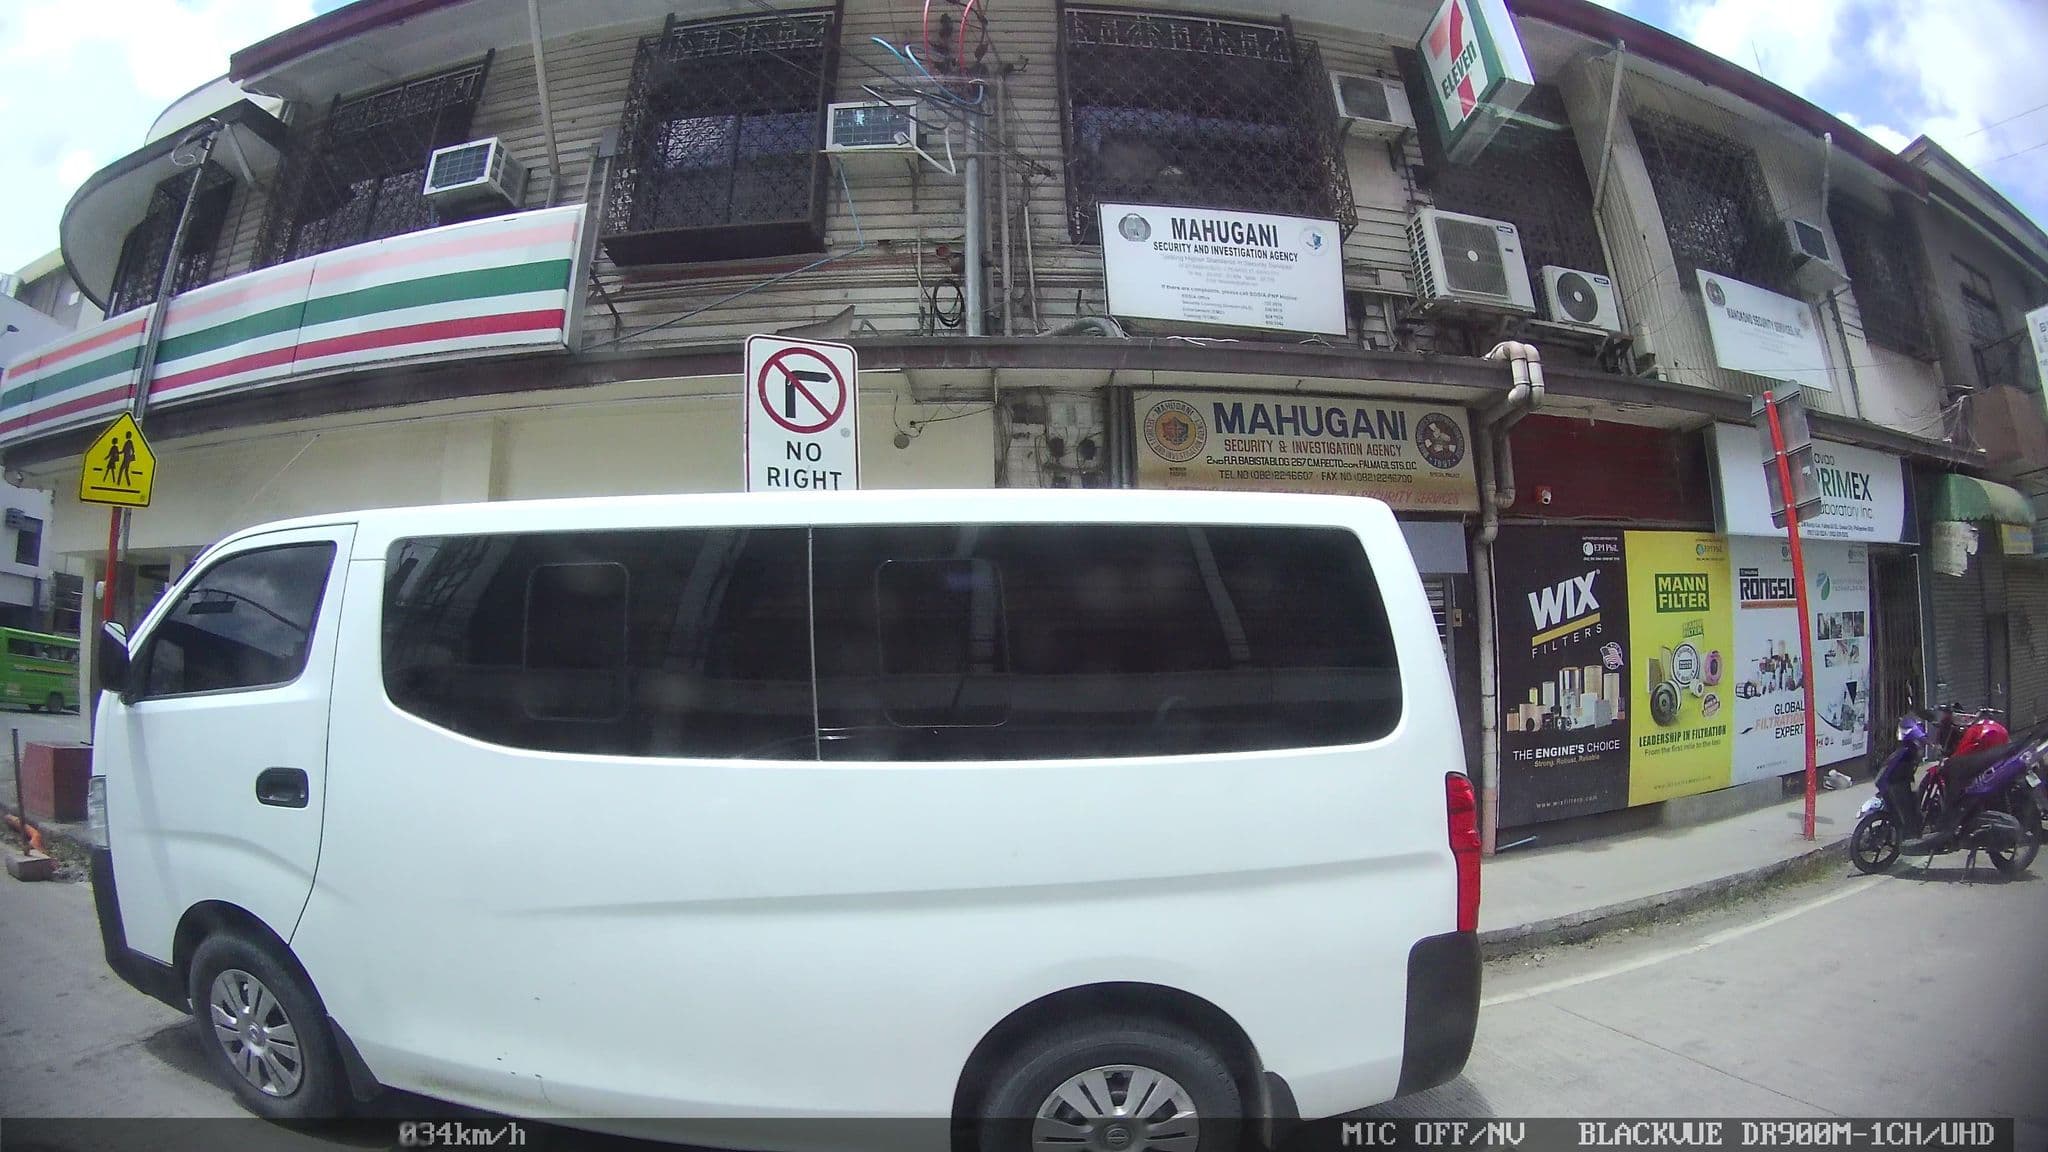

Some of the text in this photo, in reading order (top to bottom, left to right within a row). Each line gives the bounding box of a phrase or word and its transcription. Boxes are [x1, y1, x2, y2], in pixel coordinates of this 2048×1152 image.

[1170, 217, 1279, 248] MAHUGANI
[1153, 241, 1298, 262] SECURITY AND INVESTIGATION AGENCY
[1212, 402, 1408, 441] MAHUGANI
[786, 440, 822, 462] NO
[1224, 439, 1402, 457] SECURITY & INVESTIGATION AGENCY
[1813, 453, 1835, 466] avao
[767, 466, 842, 490] RIGHT
[1321, 471, 1337, 480] FAX
[1658, 576, 1707, 592] MANN
[1528, 570, 1600, 630] WIX
[1659, 592, 1707, 609] FILTER
[1532, 623, 1602, 659] FILTERS
[1774, 701, 1805, 715] GLOBAL
[1639, 725, 1727, 748] LEADERSHIP IN FILTRATION
[1775, 724, 1804, 739] EXPERT
[1512, 739, 1620, 760] THE ENGINE'S CHOICE
[1672, 744, 1683, 752] first
